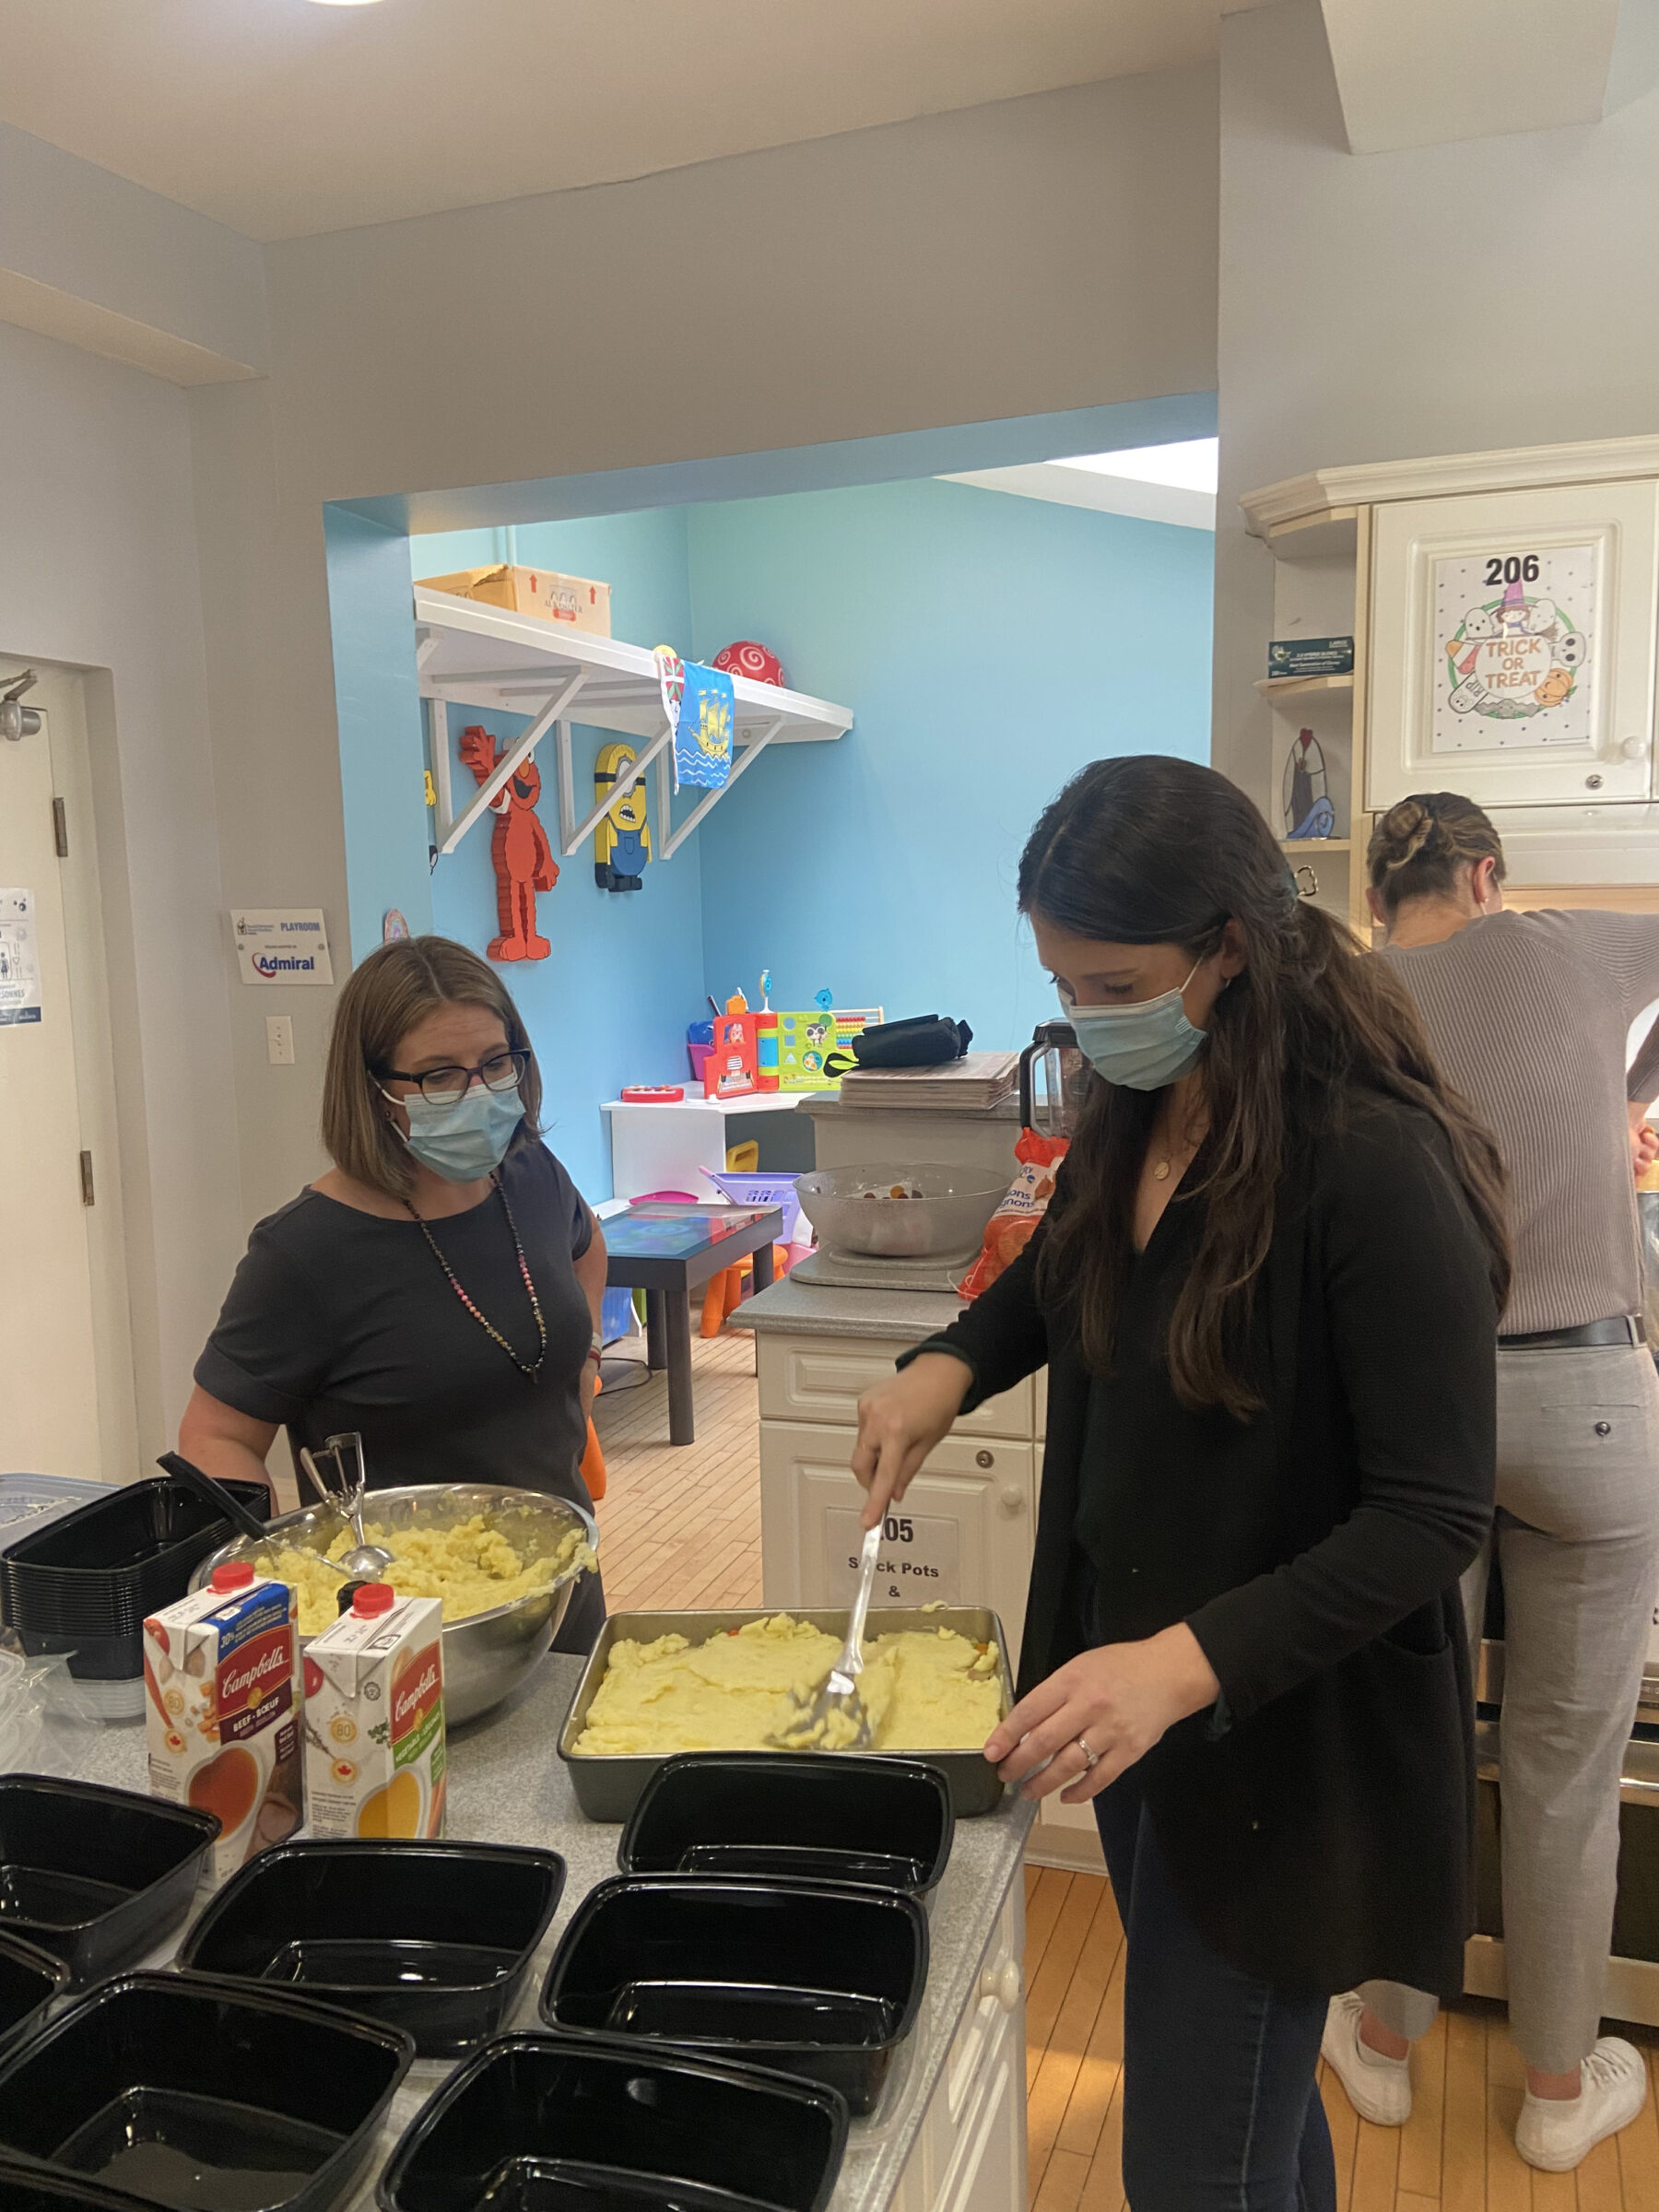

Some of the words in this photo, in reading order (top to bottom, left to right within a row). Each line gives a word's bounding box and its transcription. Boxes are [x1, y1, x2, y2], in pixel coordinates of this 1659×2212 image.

[1486, 555, 1539, 586] 206
[1486, 638, 1542, 657] TRICK
[1502, 657, 1524, 671] OR
[1465, 679, 1486, 698] RIP
[1485, 670, 1541, 689] TREAT
[280, 922, 320, 932] PLAYROOM
[259, 956, 314, 971] Admiral
[880, 1517, 913, 1543] 05
[848, 1557, 896, 1573] Sck
[901, 1562, 939, 1578] Pots
[888, 1585, 900, 1597] &
[222, 1645, 288, 1699] Campbell's
[394, 1663, 441, 1722] Campbell's
[233, 1713, 251, 1733] BEEF
[336, 1724, 349, 1737] 80
